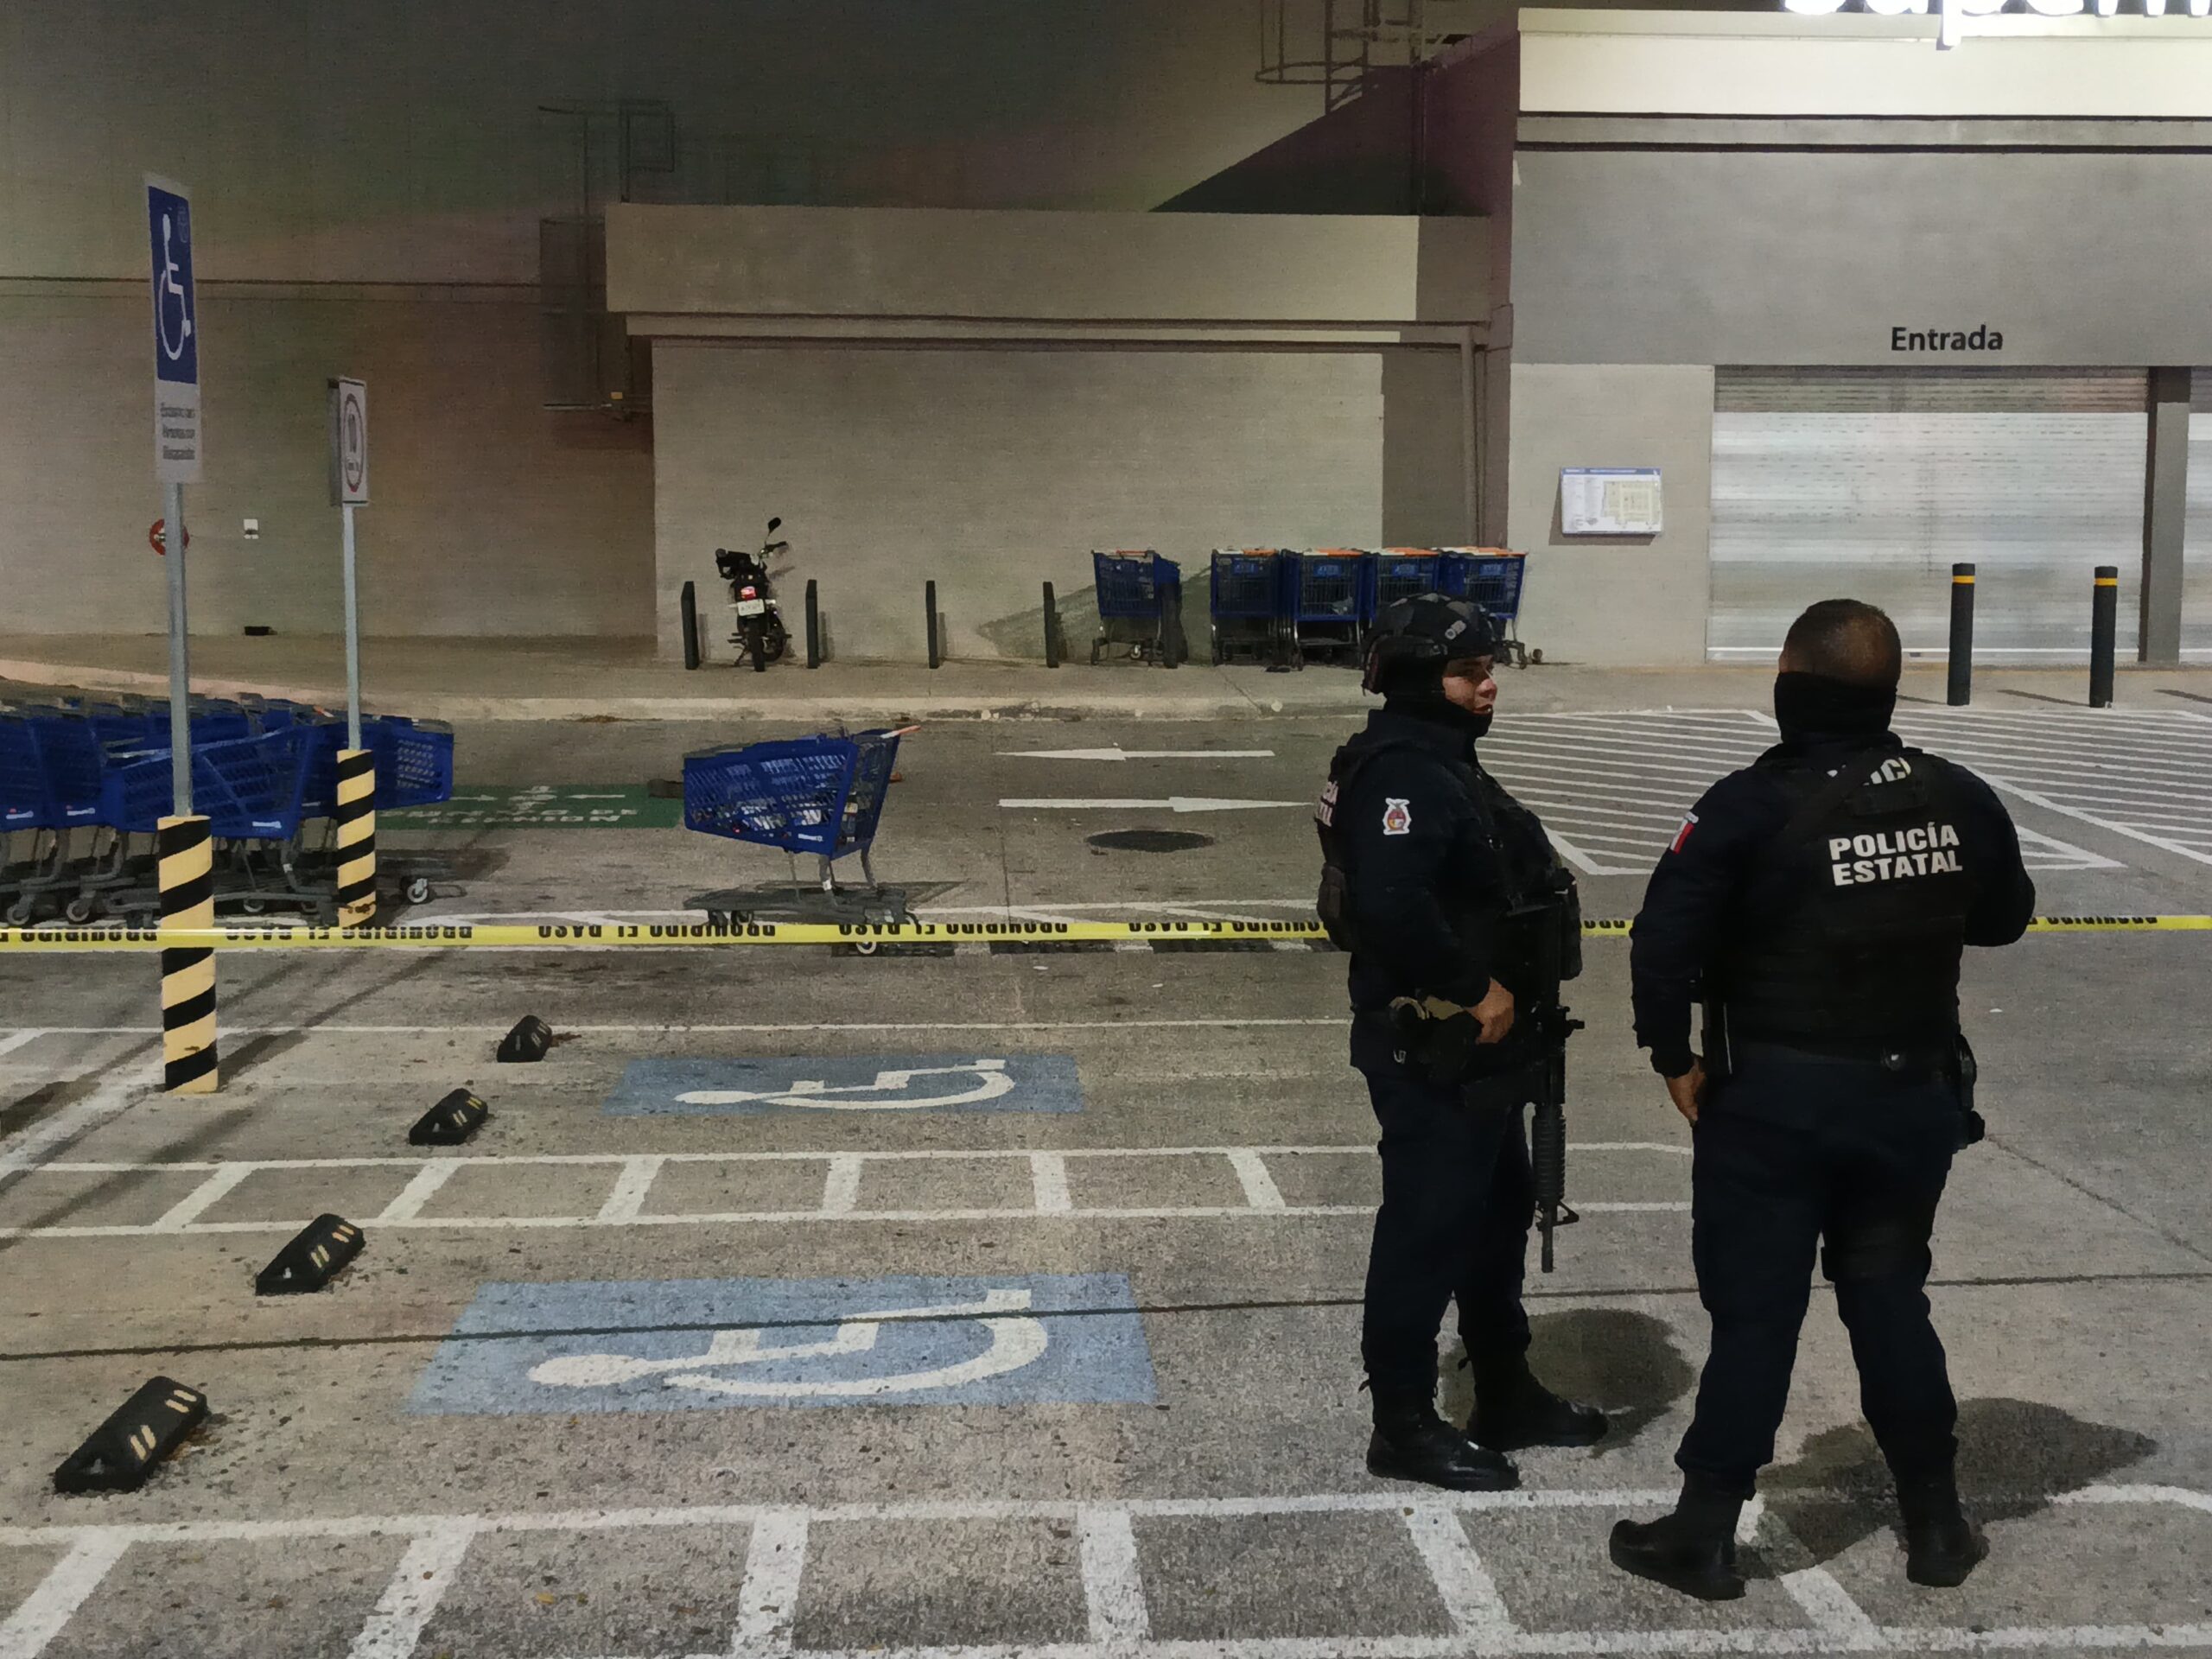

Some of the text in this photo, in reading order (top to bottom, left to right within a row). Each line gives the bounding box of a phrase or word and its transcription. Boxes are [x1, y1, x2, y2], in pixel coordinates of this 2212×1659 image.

[1891, 324, 2004, 351] Entrada
[1828, 822, 1961, 861] POLICÍA
[1832, 850, 1964, 887] ESTATAL
